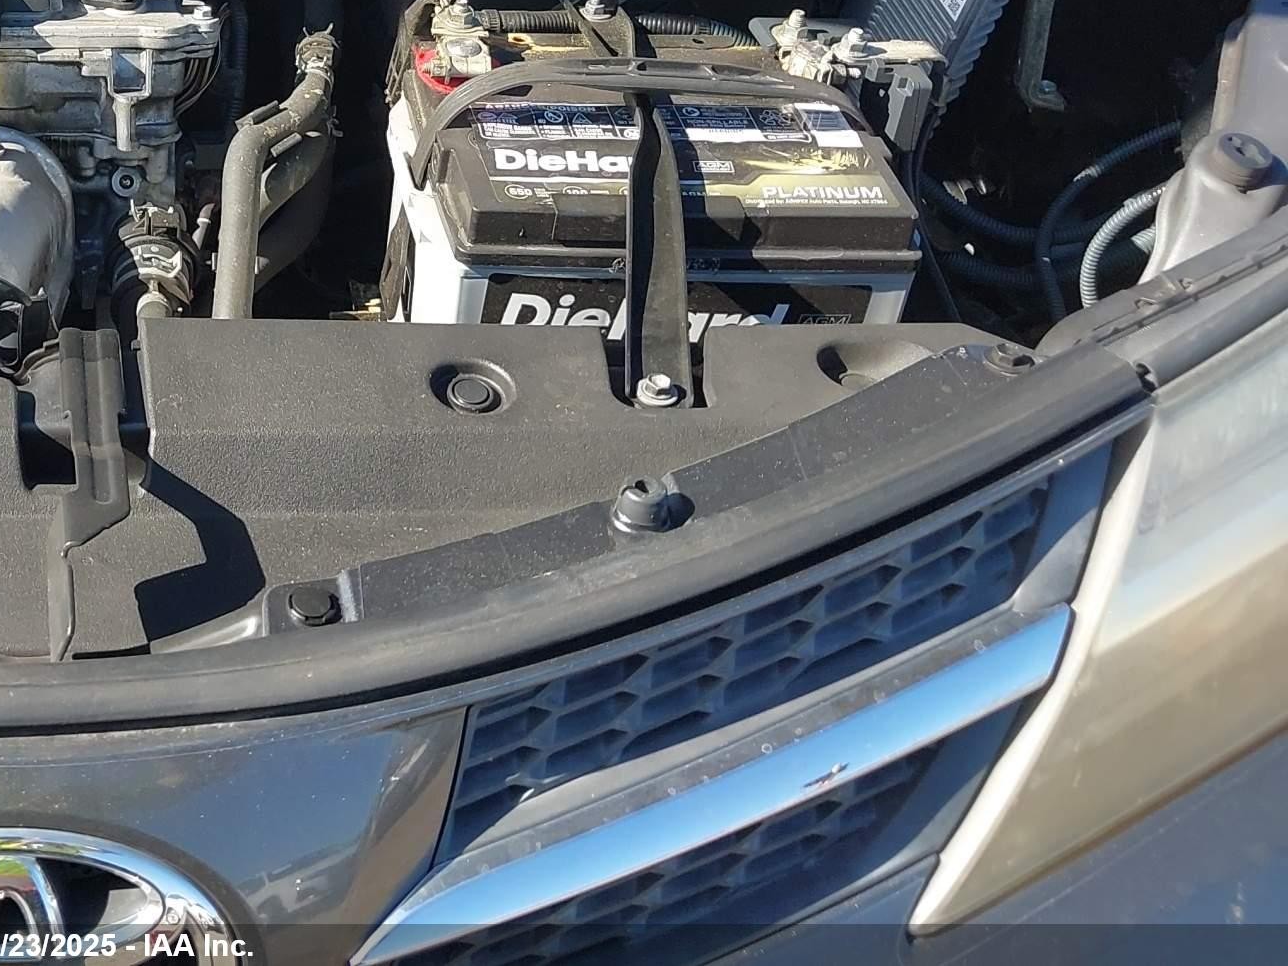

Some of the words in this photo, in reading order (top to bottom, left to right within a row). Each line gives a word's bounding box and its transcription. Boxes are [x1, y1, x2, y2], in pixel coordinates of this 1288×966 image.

[494, 148, 633, 172] DieHa
[761, 186, 883, 199] PLATINUM
[500, 292, 791, 343] Dieard
